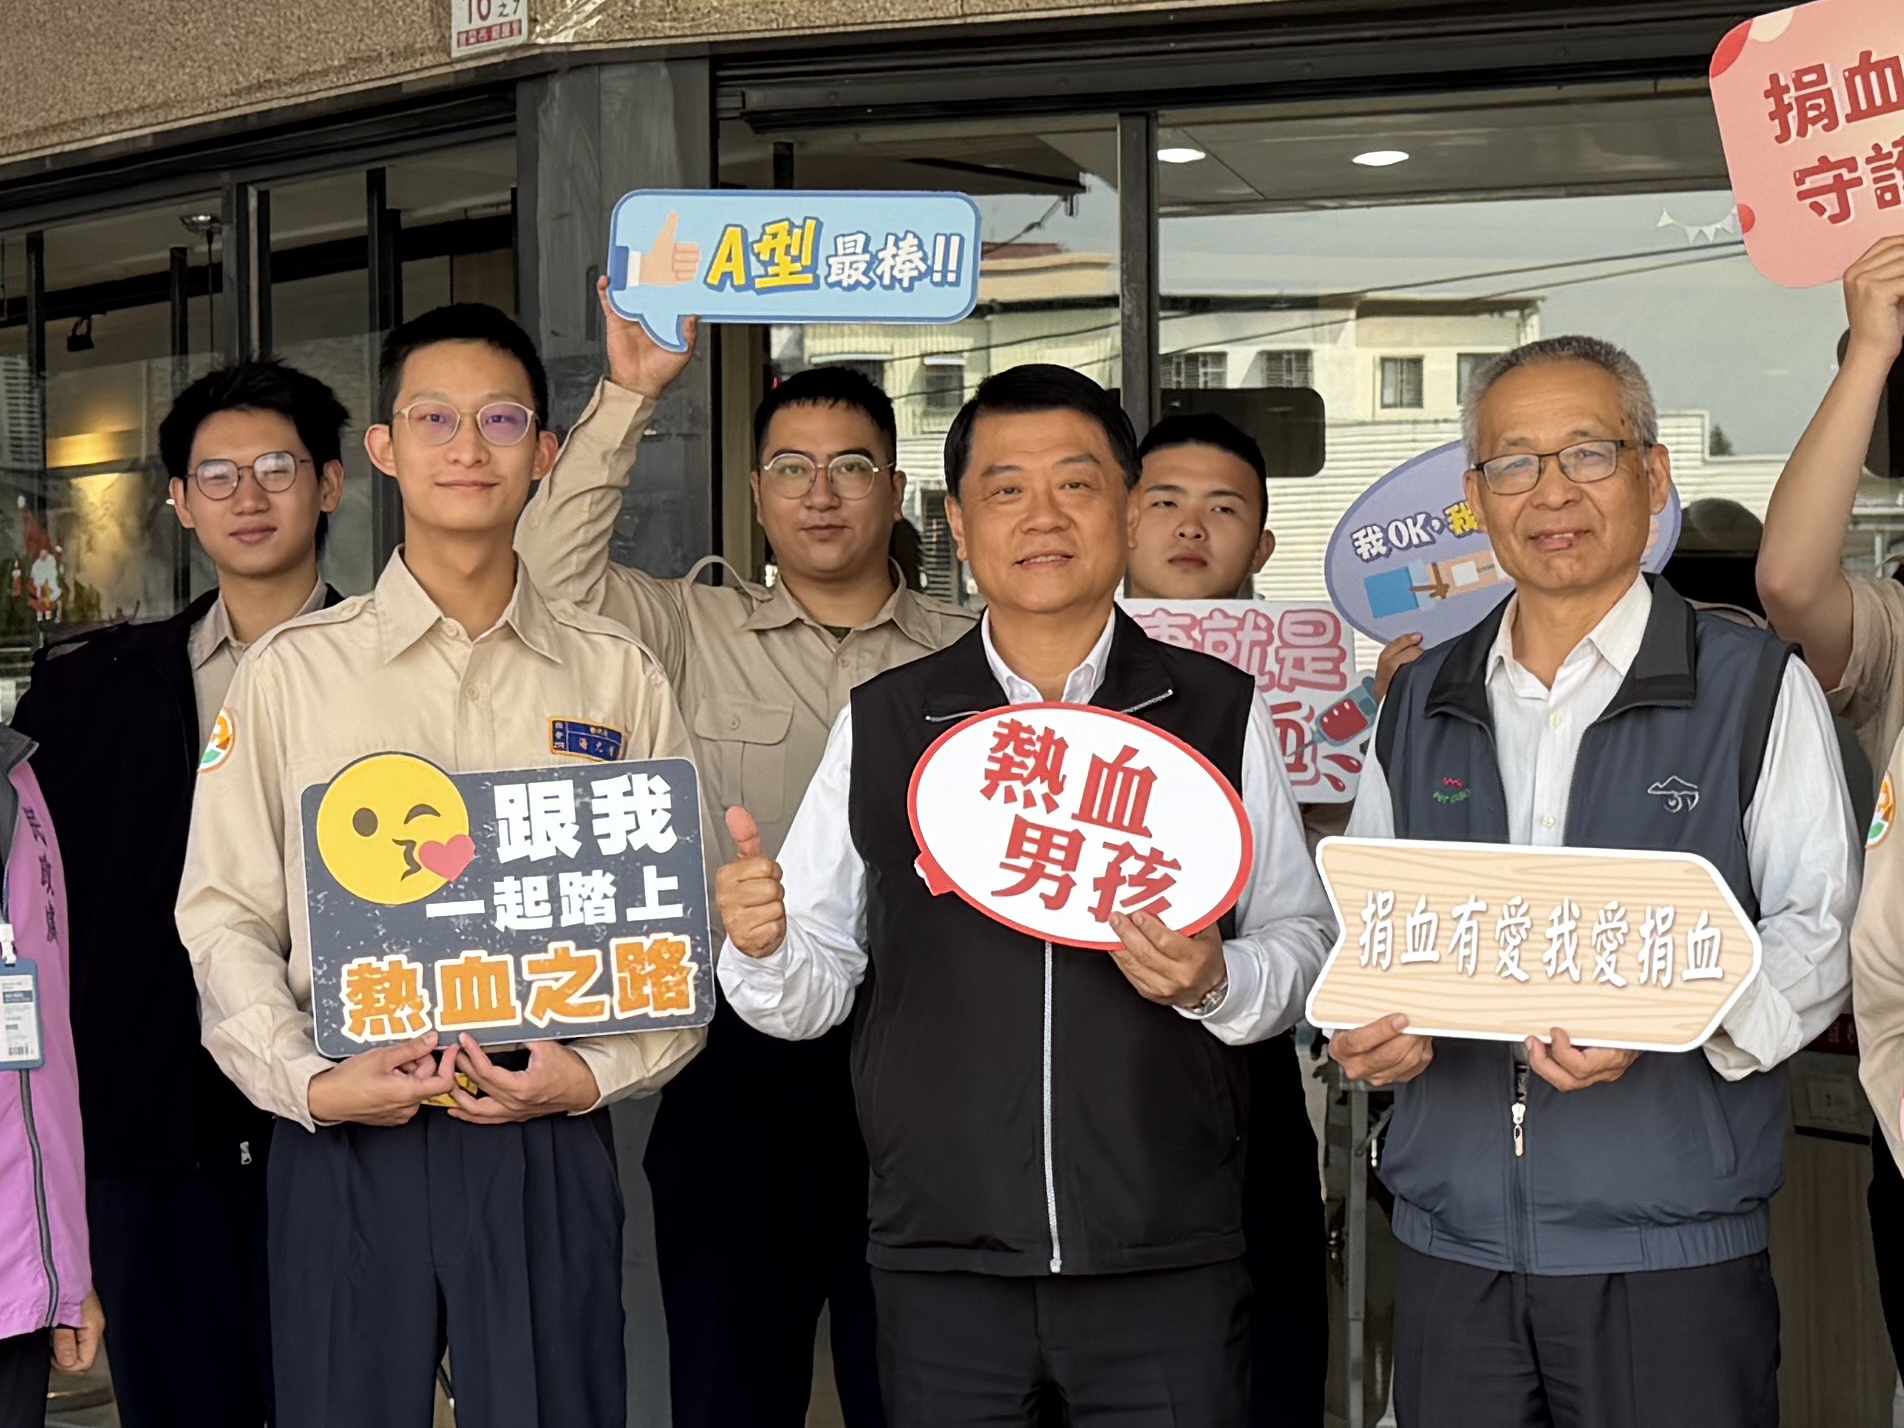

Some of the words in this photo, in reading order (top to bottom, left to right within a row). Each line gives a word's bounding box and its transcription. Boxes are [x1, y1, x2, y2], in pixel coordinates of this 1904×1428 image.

[494, 774, 678, 862] 跟我
[979, 717, 1157, 841] 熱血
[424, 865, 685, 933] 一起踏上
[992, 815, 1183, 922] 男孩
[339, 933, 700, 1045] 熱血之路
[1358, 890, 1726, 990] 捐血有愛我愛捐血
